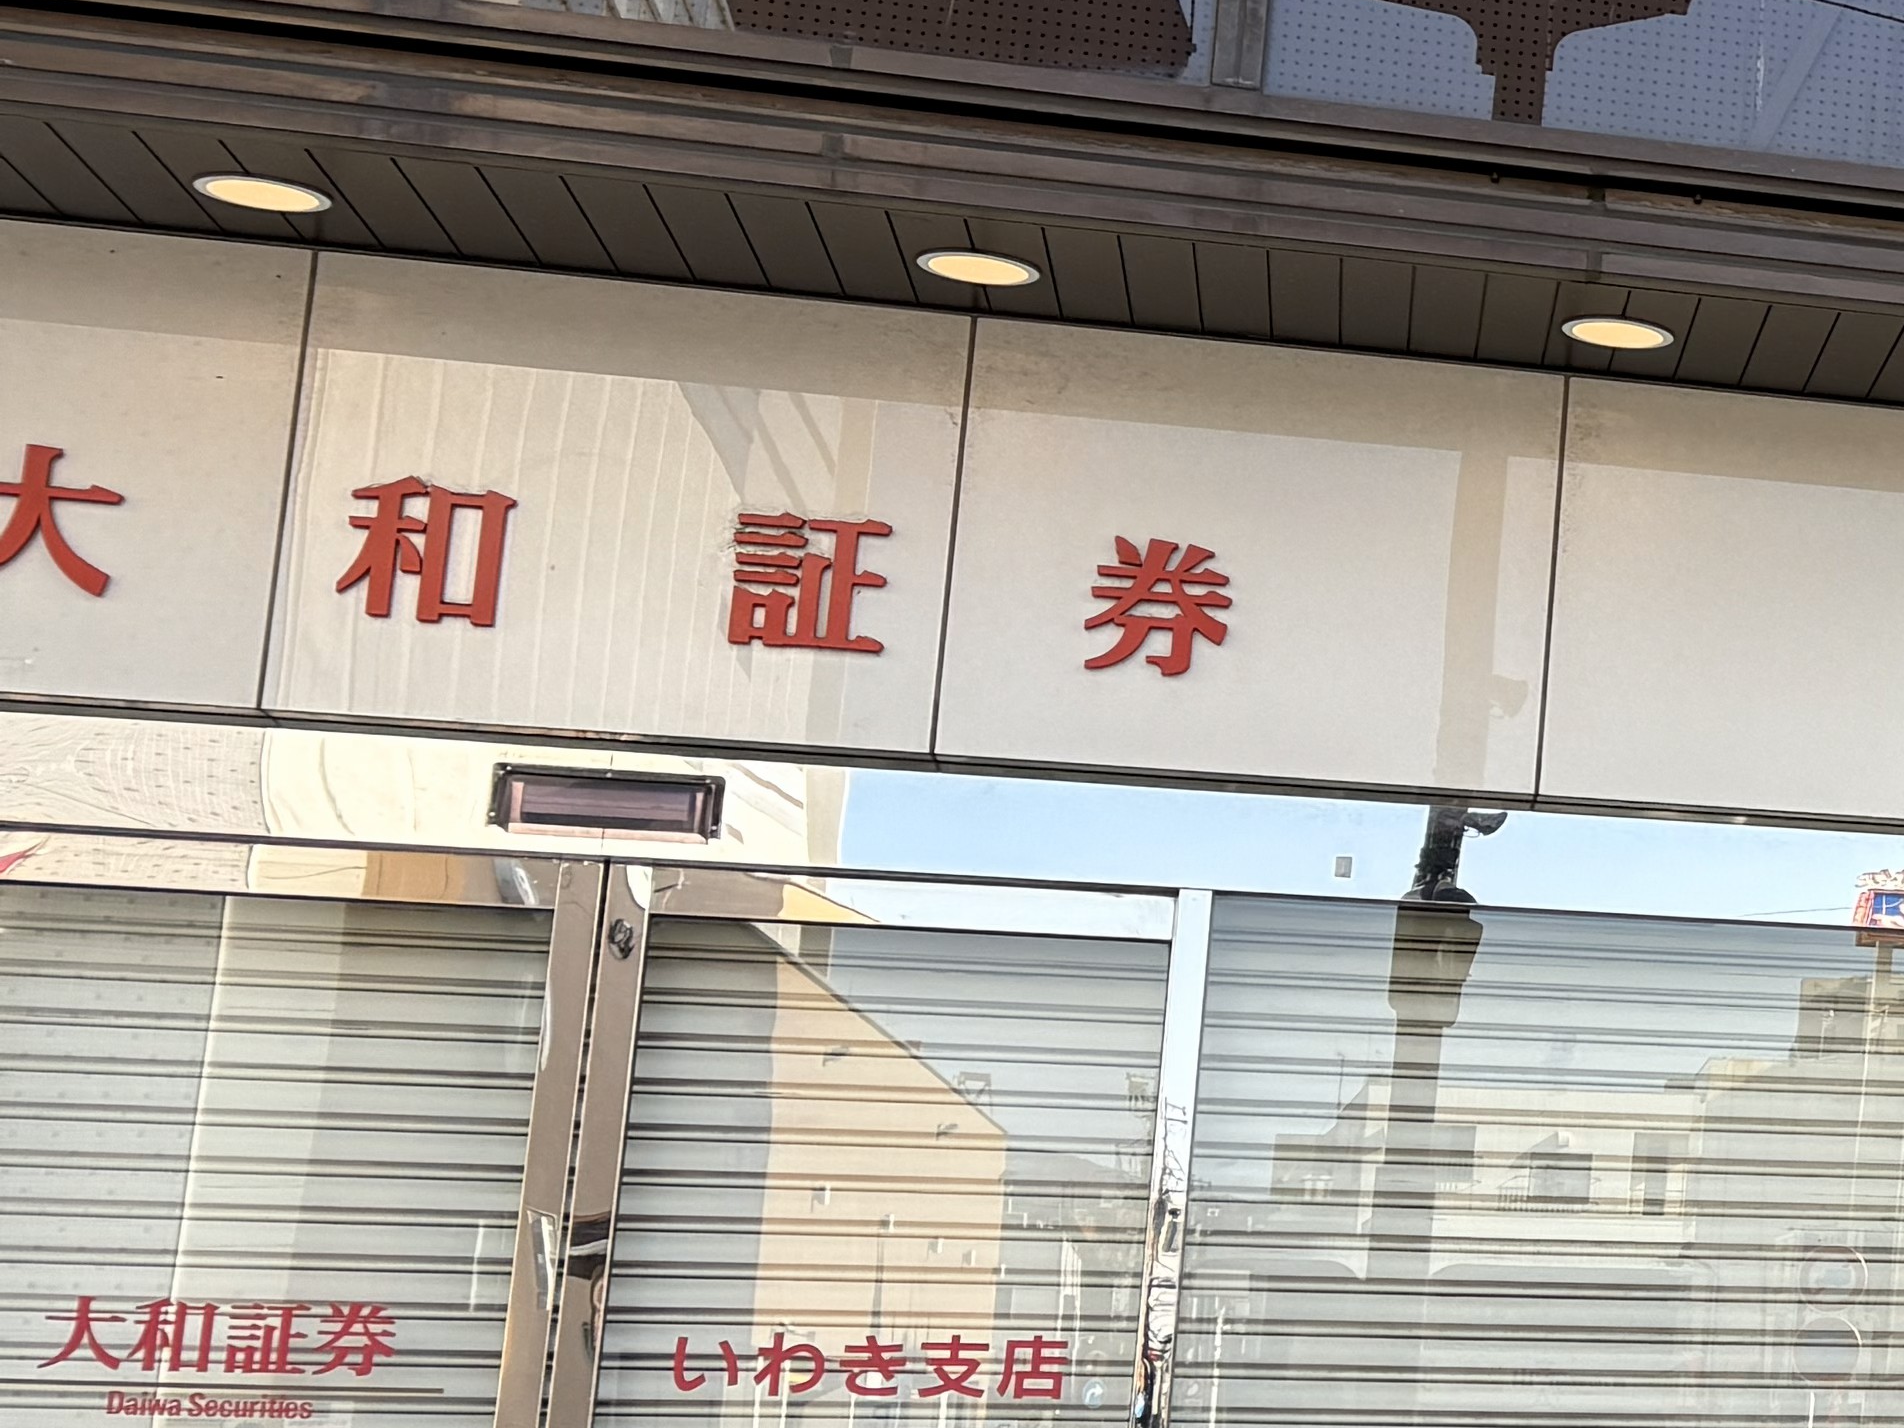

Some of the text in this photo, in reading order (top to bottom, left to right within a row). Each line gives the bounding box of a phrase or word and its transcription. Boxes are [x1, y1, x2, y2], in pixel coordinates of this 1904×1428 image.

[0, 444, 1234, 677] 大和証券
[37, 1295, 397, 1377] 大和証券
[673, 1332, 1069, 1400] いわき支店
[106, 1391, 314, 1419] Daiwa Securities
